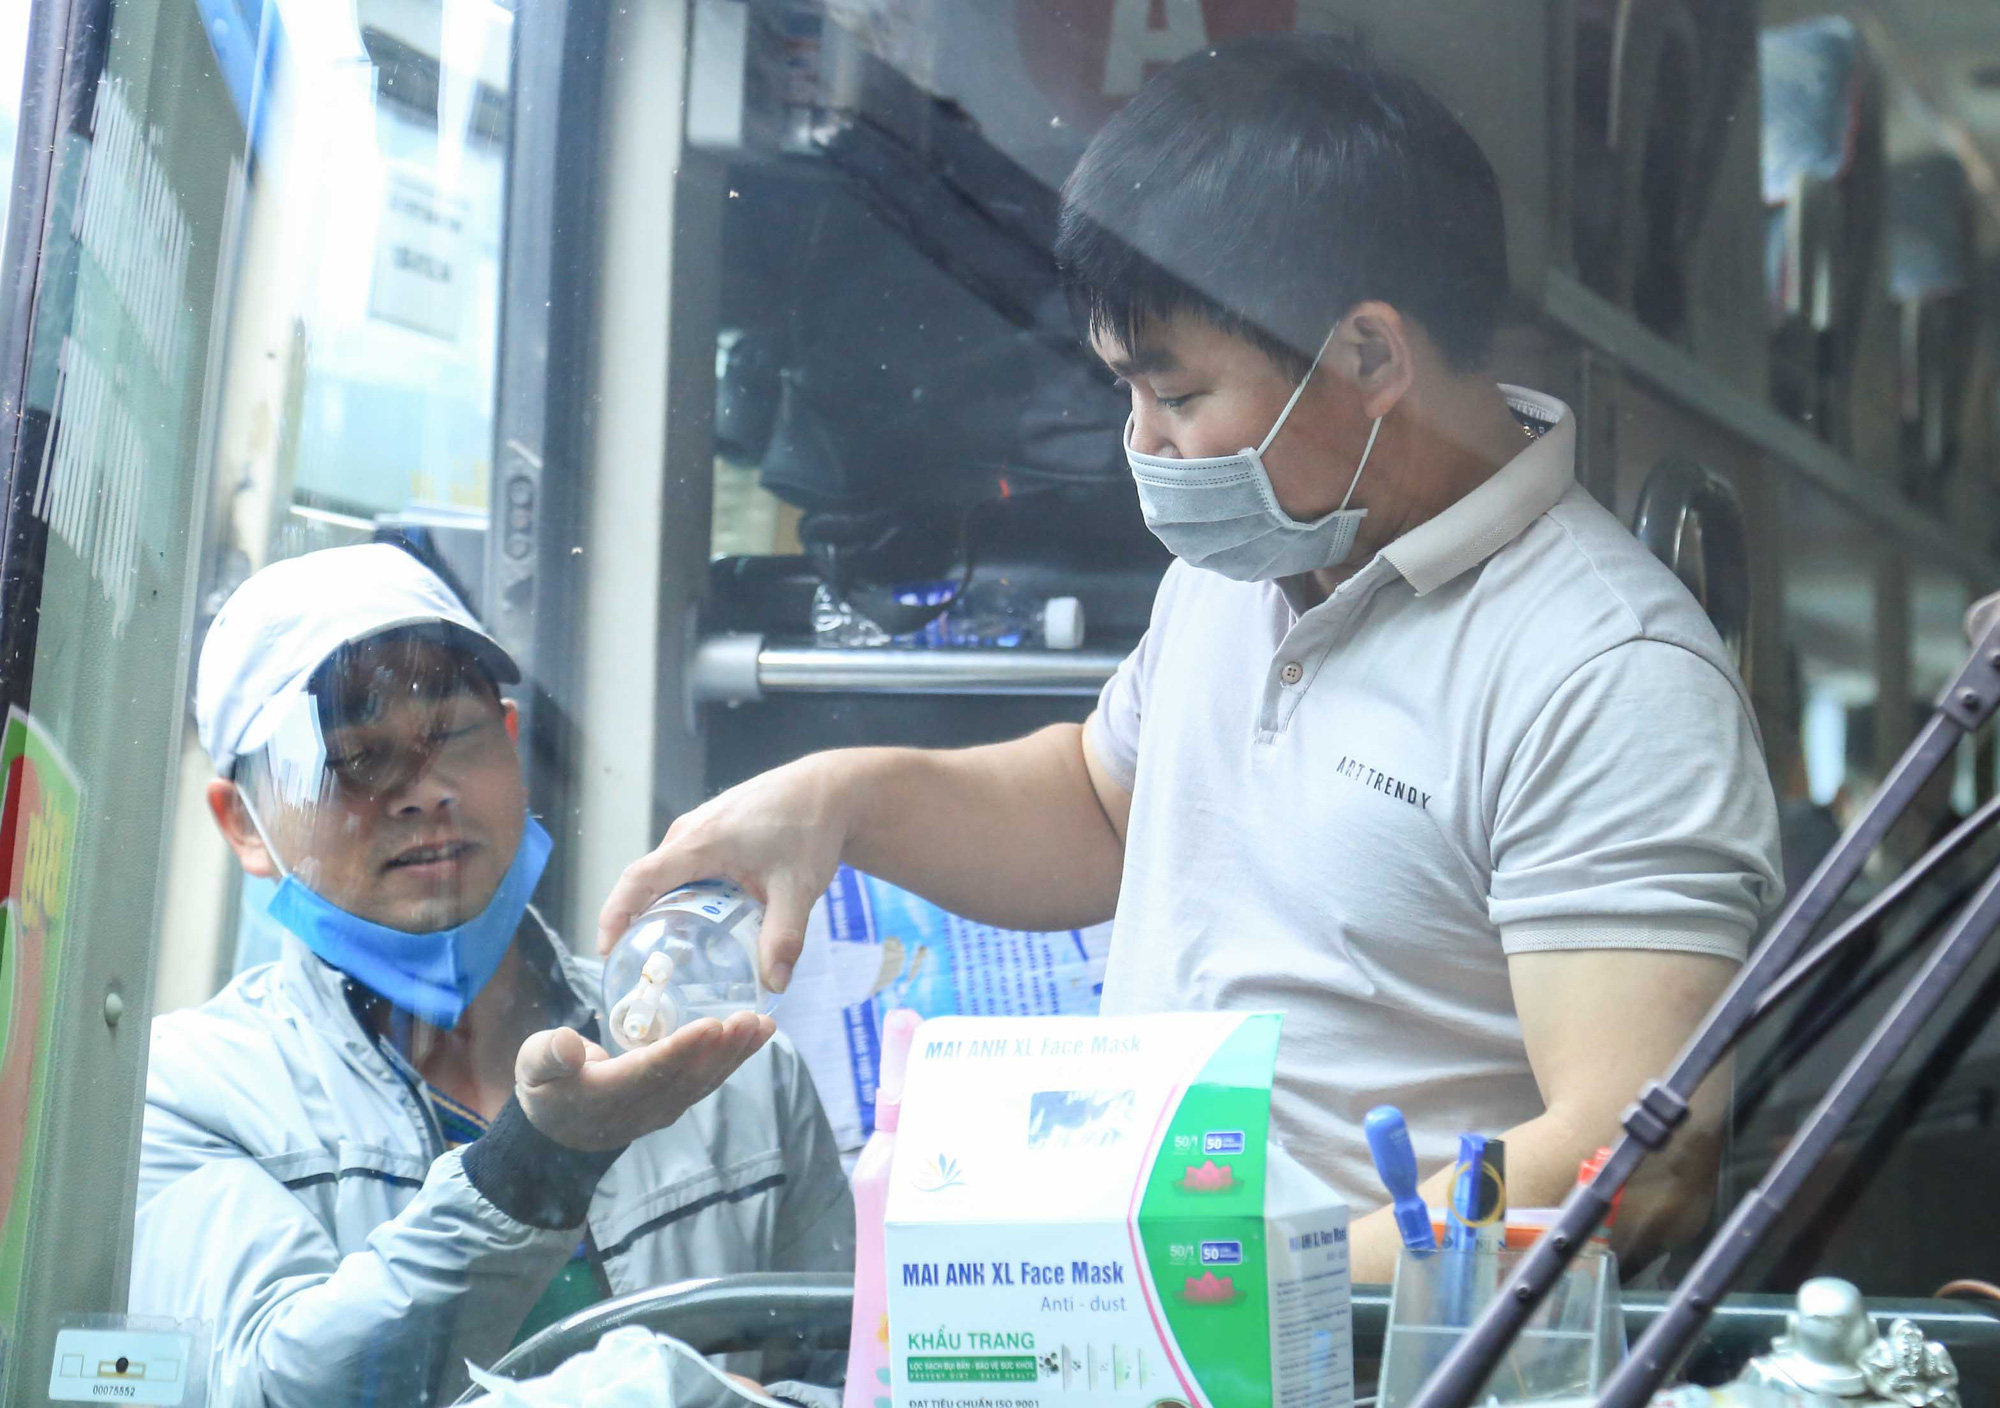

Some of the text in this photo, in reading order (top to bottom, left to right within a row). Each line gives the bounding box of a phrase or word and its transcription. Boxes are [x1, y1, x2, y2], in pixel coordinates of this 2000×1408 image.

[925, 1041, 962, 1060] MAI
[968, 1039, 1007, 1059] ANH
[1041, 1037, 1083, 1057] Face
[1090, 1034, 1140, 1055] Mask
[1203, 1248, 1219, 1261] 50
[902, 1261, 1124, 1287] MAI ANH XL Face Mask
[1040, 1296, 1074, 1313] Anti
[1090, 1295, 1127, 1312] dust
[908, 1324, 1036, 1350] KHẨU TRANG
[92, 1384, 136, 1398] 00075552
